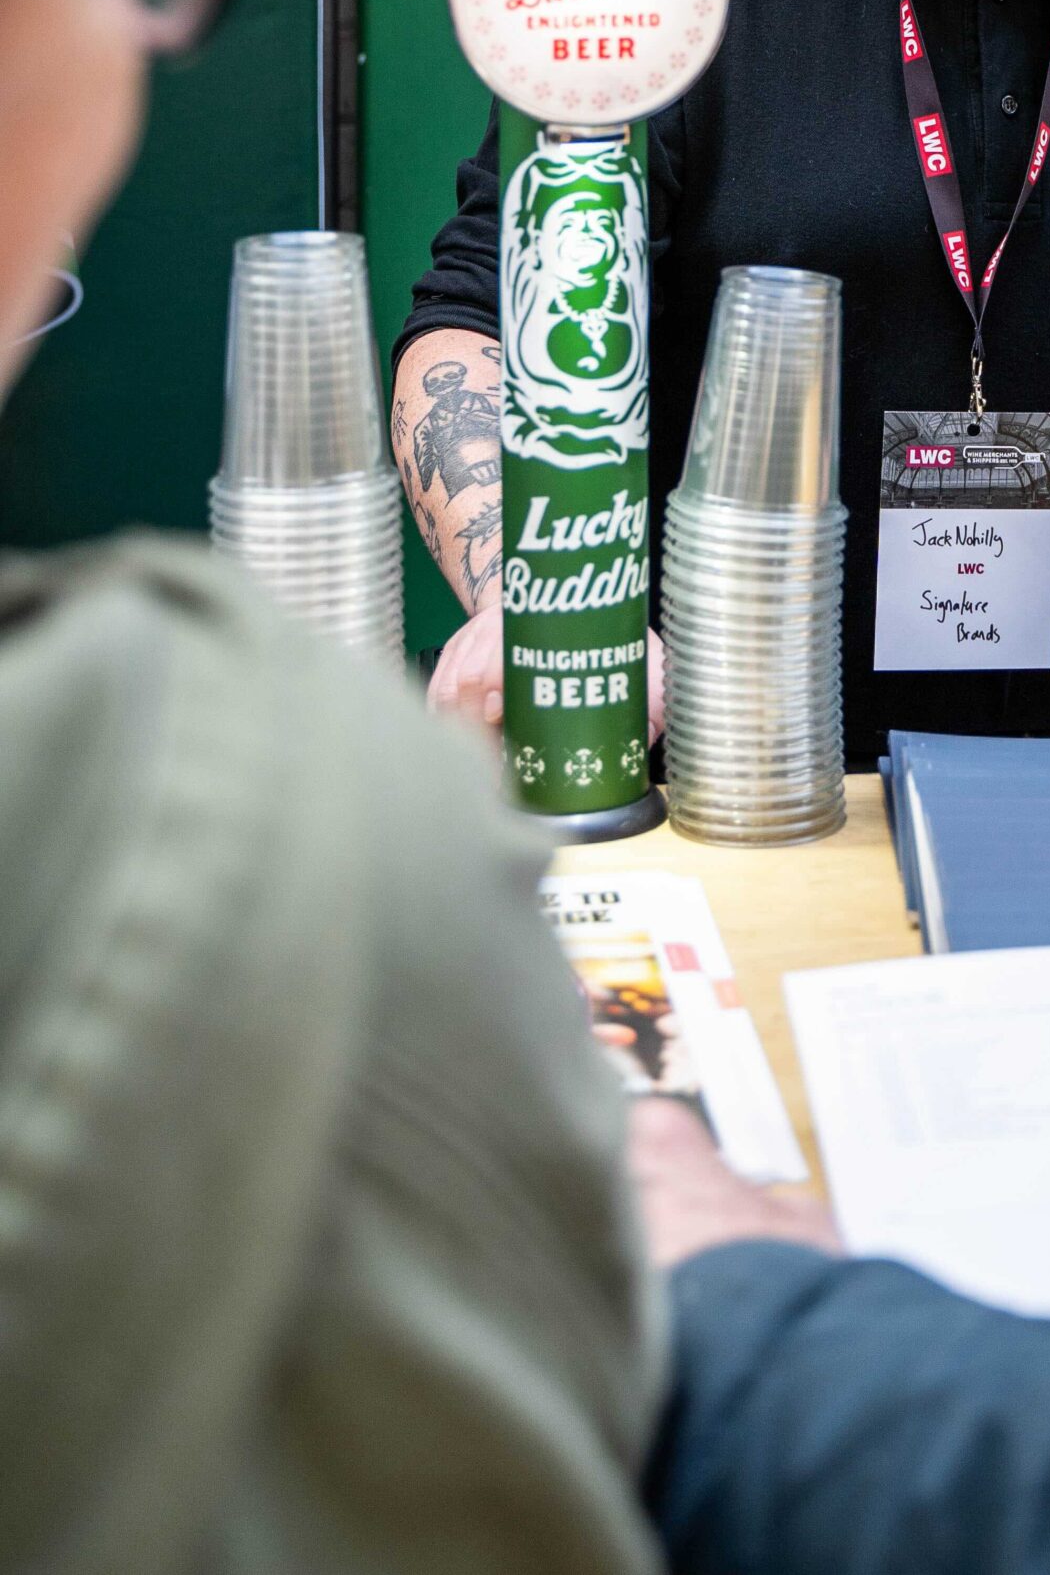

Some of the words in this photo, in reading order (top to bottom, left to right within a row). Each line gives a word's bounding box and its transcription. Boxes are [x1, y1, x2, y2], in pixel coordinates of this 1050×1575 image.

[527, 13, 661, 30] ENLIGHTENED
[900, 4, 919, 57] LWC
[553, 38, 636, 61] BEER
[917, 118, 946, 172] LWC
[1029, 128, 1049, 181] LWC
[947, 235, 970, 289] LWC
[909, 449, 952, 465] LWC
[516, 489, 648, 551] Lucky
[912, 518, 952, 547] Jack
[957, 563, 985, 575] LWC
[920, 590, 989, 623] Signature
[957, 622, 1001, 643] Brands
[512, 639, 645, 671] ENLIGHTENED
[533, 672, 629, 708] BEER
